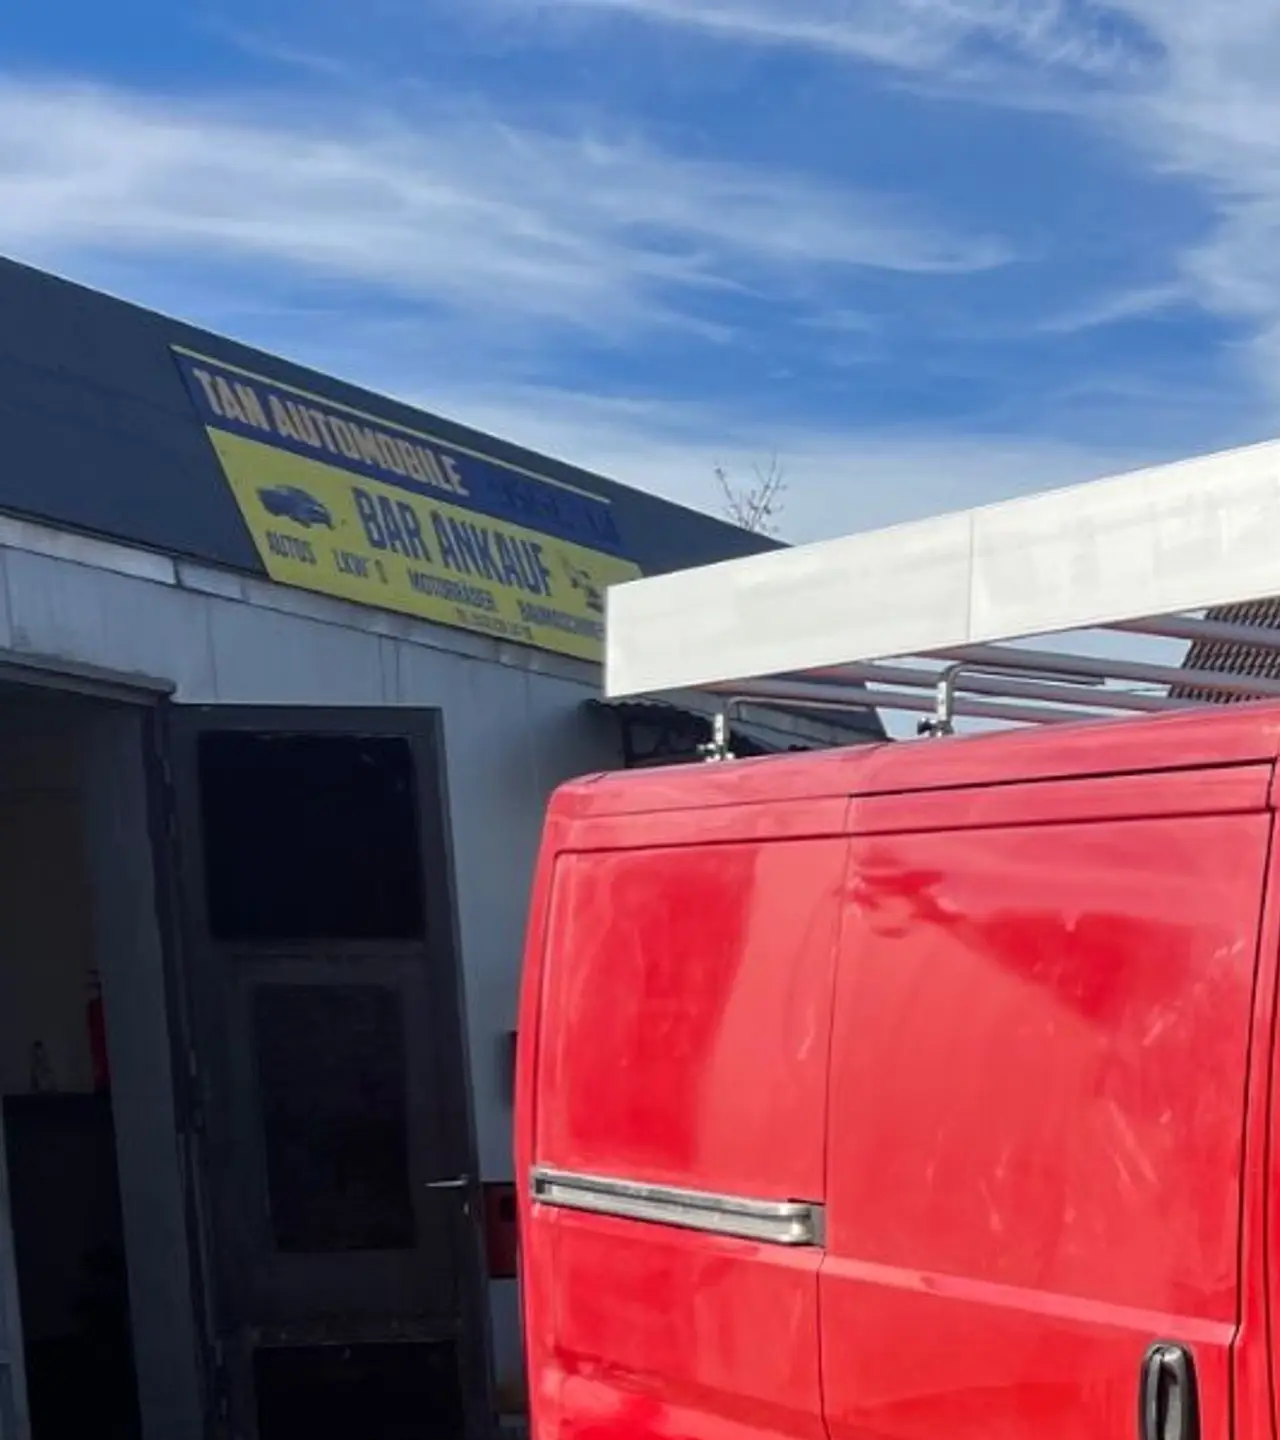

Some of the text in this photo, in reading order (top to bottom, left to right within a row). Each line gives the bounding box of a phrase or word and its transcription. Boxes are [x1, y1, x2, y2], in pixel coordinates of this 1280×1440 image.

[191, 367, 471, 498] TAN AUTOMOBILE
[350, 485, 434, 565] BAR
[429, 508, 554, 598] ANKAUF
